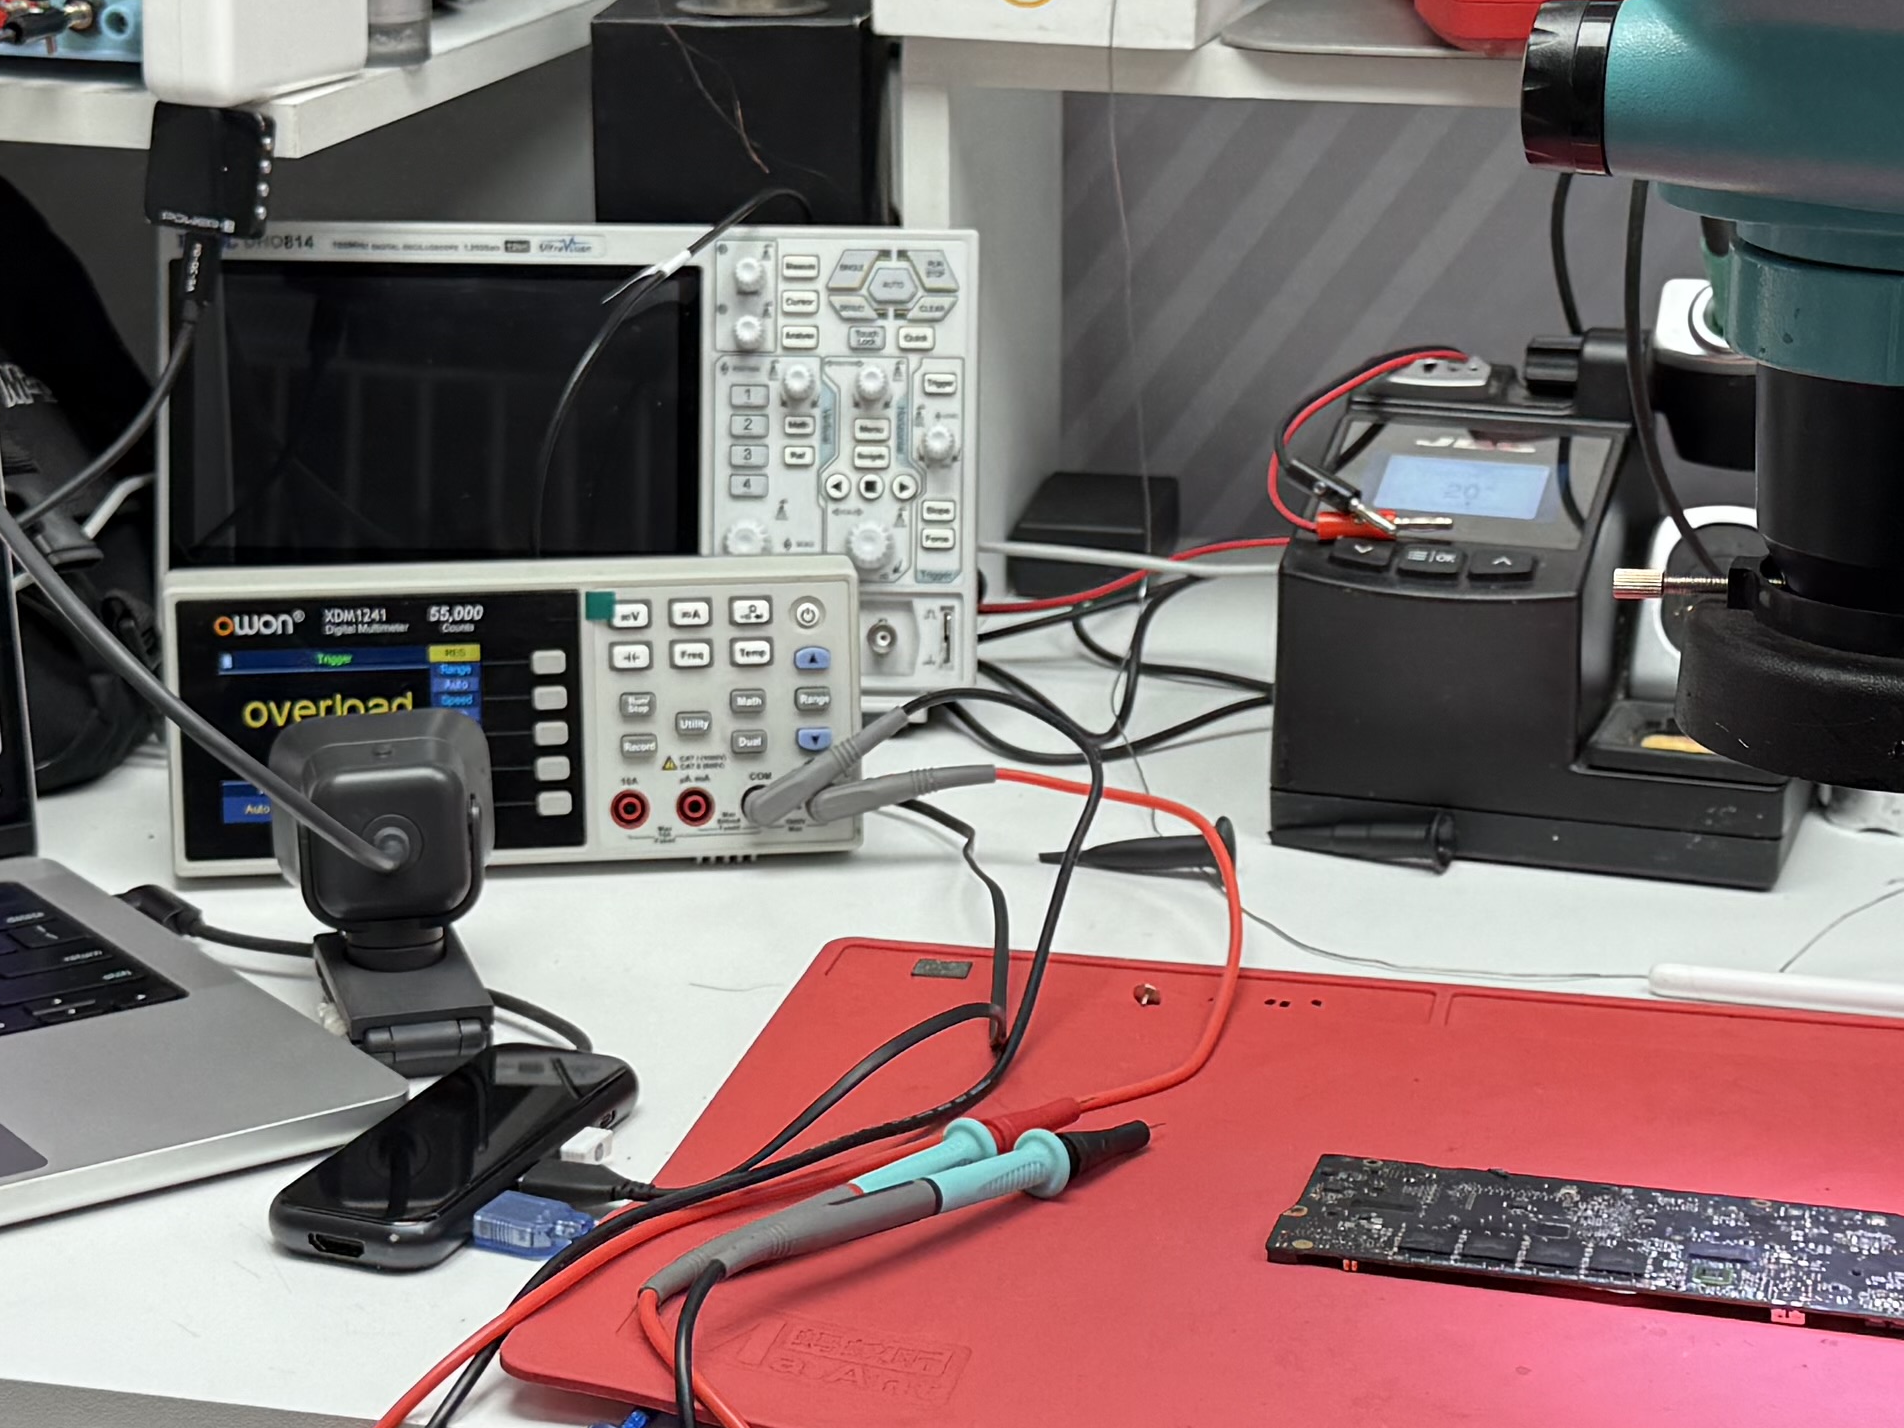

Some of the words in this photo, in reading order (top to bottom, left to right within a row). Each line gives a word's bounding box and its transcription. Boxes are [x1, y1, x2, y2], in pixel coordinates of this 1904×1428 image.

[883, 281, 904, 289] AUTO
[786, 297, 814, 306] Cursor
[919, 305, 944, 313] CLEAR
[855, 330, 878, 338] Touch
[857, 338, 876, 346] Lock
[745, 389, 751, 400] 1
[744, 419, 753, 431] 2
[788, 420, 809, 429] Math
[860, 425, 884, 434] Menu
[743, 449, 752, 460] 3
[743, 479, 751, 490] 4
[1436, 553, 1456, 563] OK
[324, 608, 386, 623] XDM1241
[427, 605, 484, 622] 55,000
[325, 624, 356, 634] Digital
[358, 623, 409, 634] Multimeter
[440, 623, 474, 632] Counts
[680, 650, 704, 661] Freq
[740, 649, 766, 658] Temp
[315, 654, 352, 666] Trigger
[440, 664, 471, 676] Range
[445, 680, 468, 690] Auto
[442, 695, 472, 706] Speed
[737, 697, 762, 706] Math
[800, 695, 829, 705] Range
[243, 692, 413, 728] overload
[680, 719, 710, 730] Utility
[624, 742, 656, 751] Record
[739, 737, 762, 746] Dual
[621, 777, 638, 785] 10A
[749, 772, 772, 780] COM
[246, 804, 270, 814] Auto
